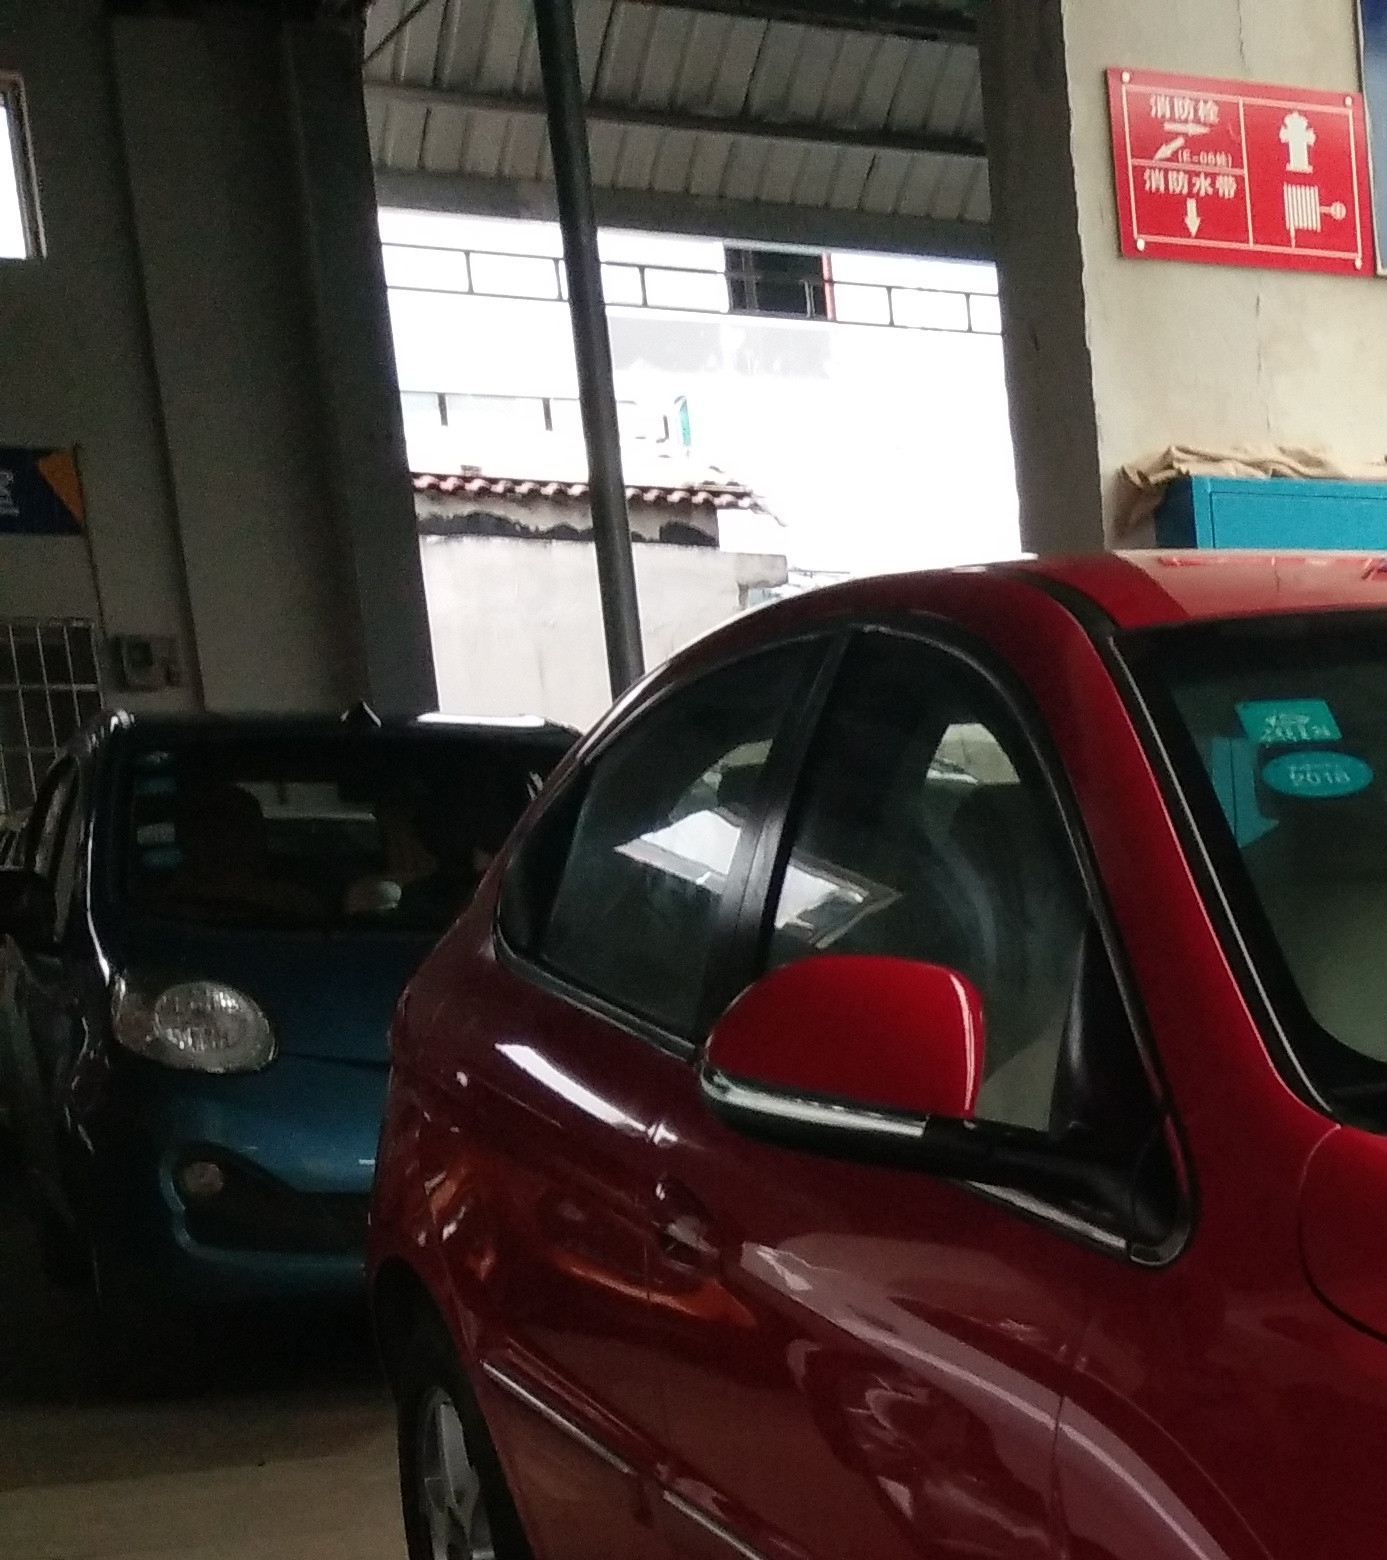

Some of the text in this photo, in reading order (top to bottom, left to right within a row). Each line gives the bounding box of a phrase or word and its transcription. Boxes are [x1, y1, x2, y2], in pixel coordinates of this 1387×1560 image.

[1150, 94, 1219, 125] 消防栓
[1143, 168, 1237, 199] 消防水带
